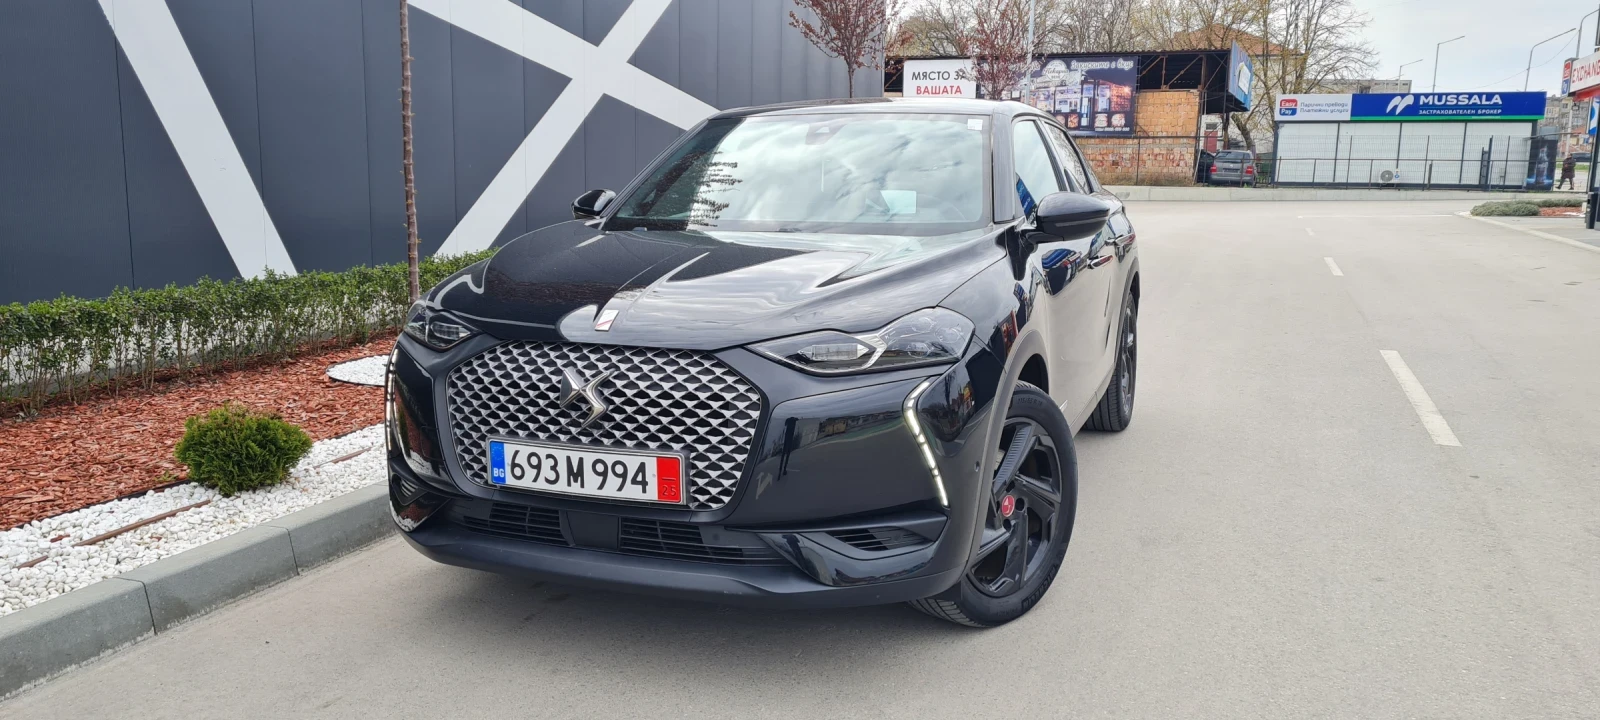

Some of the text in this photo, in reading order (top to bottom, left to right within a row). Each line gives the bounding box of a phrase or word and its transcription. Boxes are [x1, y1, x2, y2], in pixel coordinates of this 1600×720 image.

[911, 71, 951, 81] МЯСТО
[916, 85, 963, 95] ВАШАТА
[1419, 94, 1503, 105] MUSSALA
[493, 467, 505, 478] BG
[662, 484, 677, 496] 25
